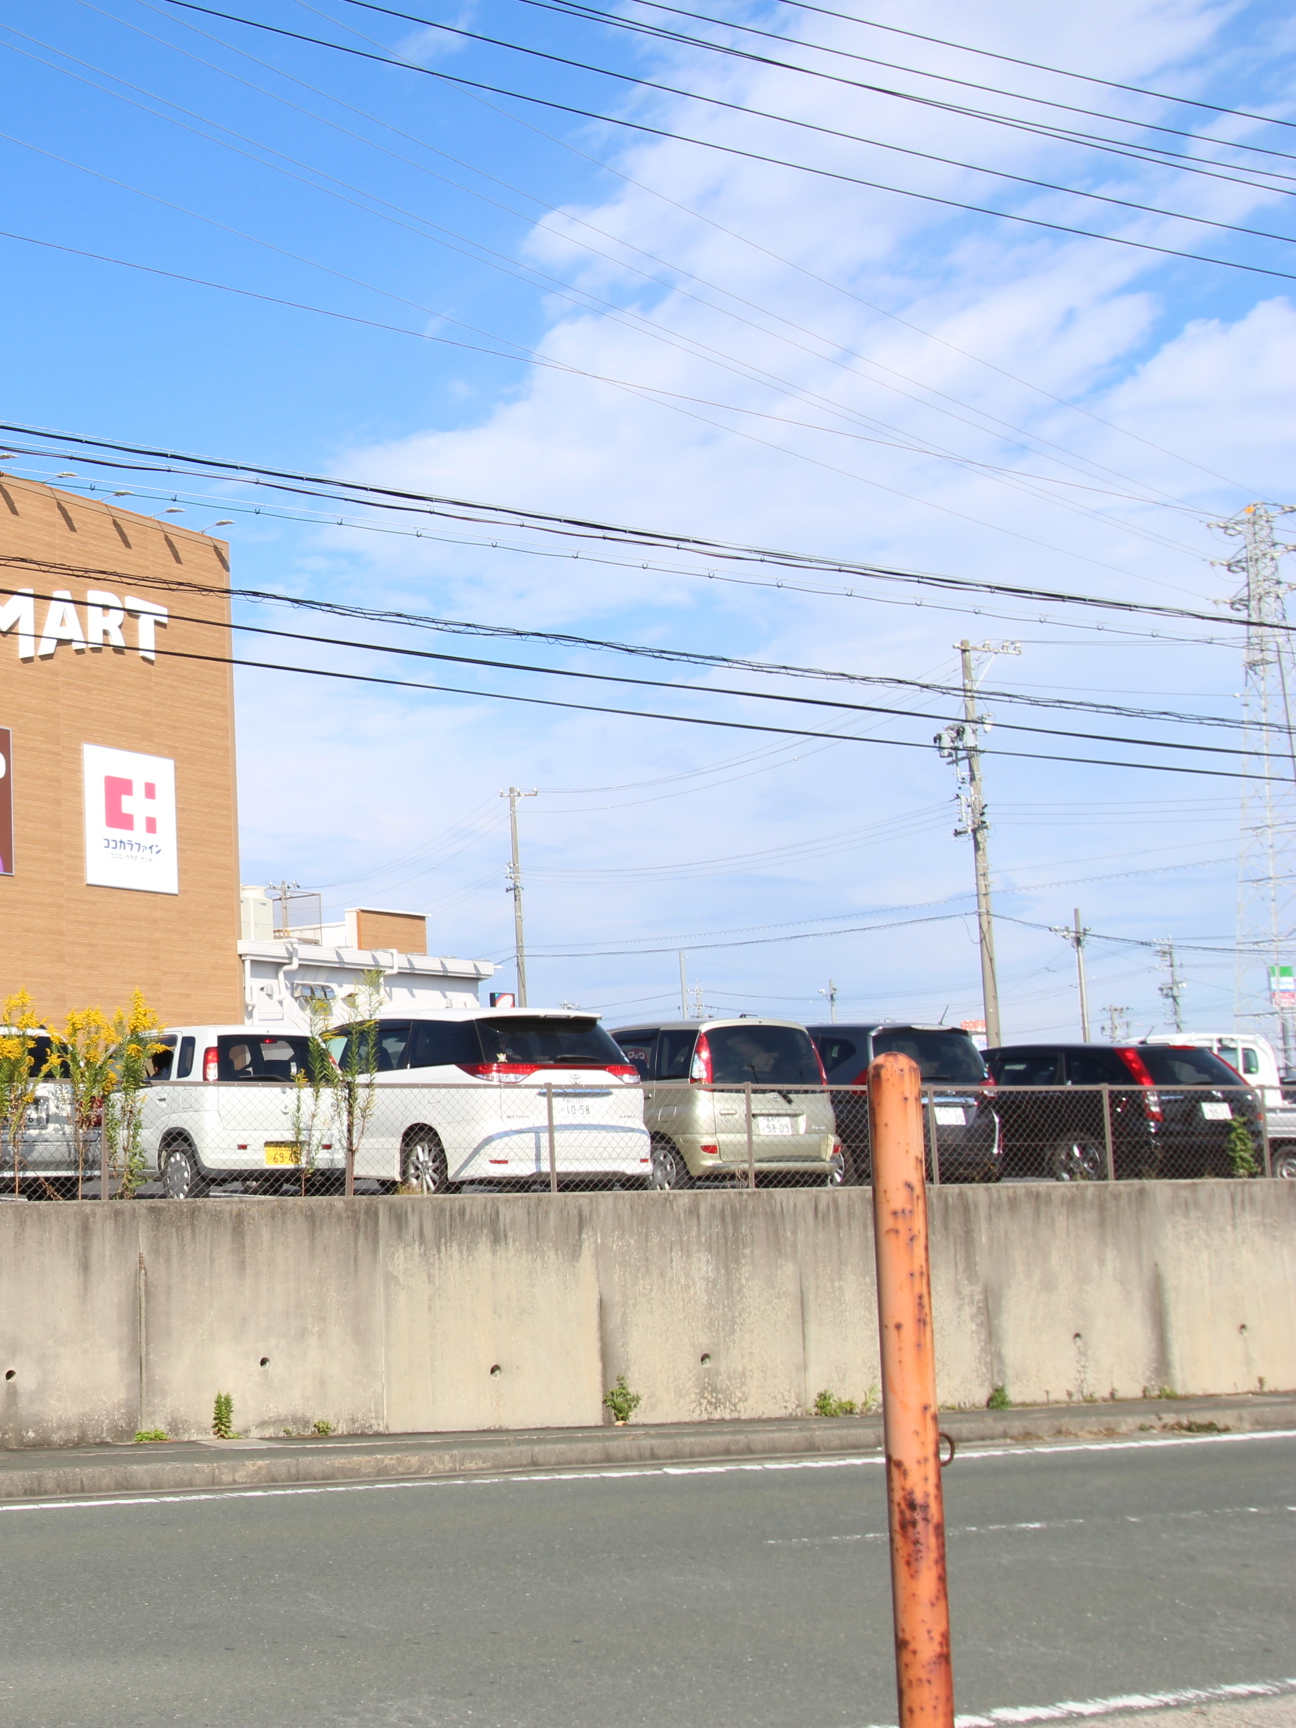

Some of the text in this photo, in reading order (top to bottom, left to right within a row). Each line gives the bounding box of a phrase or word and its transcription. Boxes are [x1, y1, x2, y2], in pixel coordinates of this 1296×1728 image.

[103, 838, 162, 855] ココカラファイン
[566, 1105, 590, 1115] 10-58
[766, 1123, 790, 1133] 98-09
